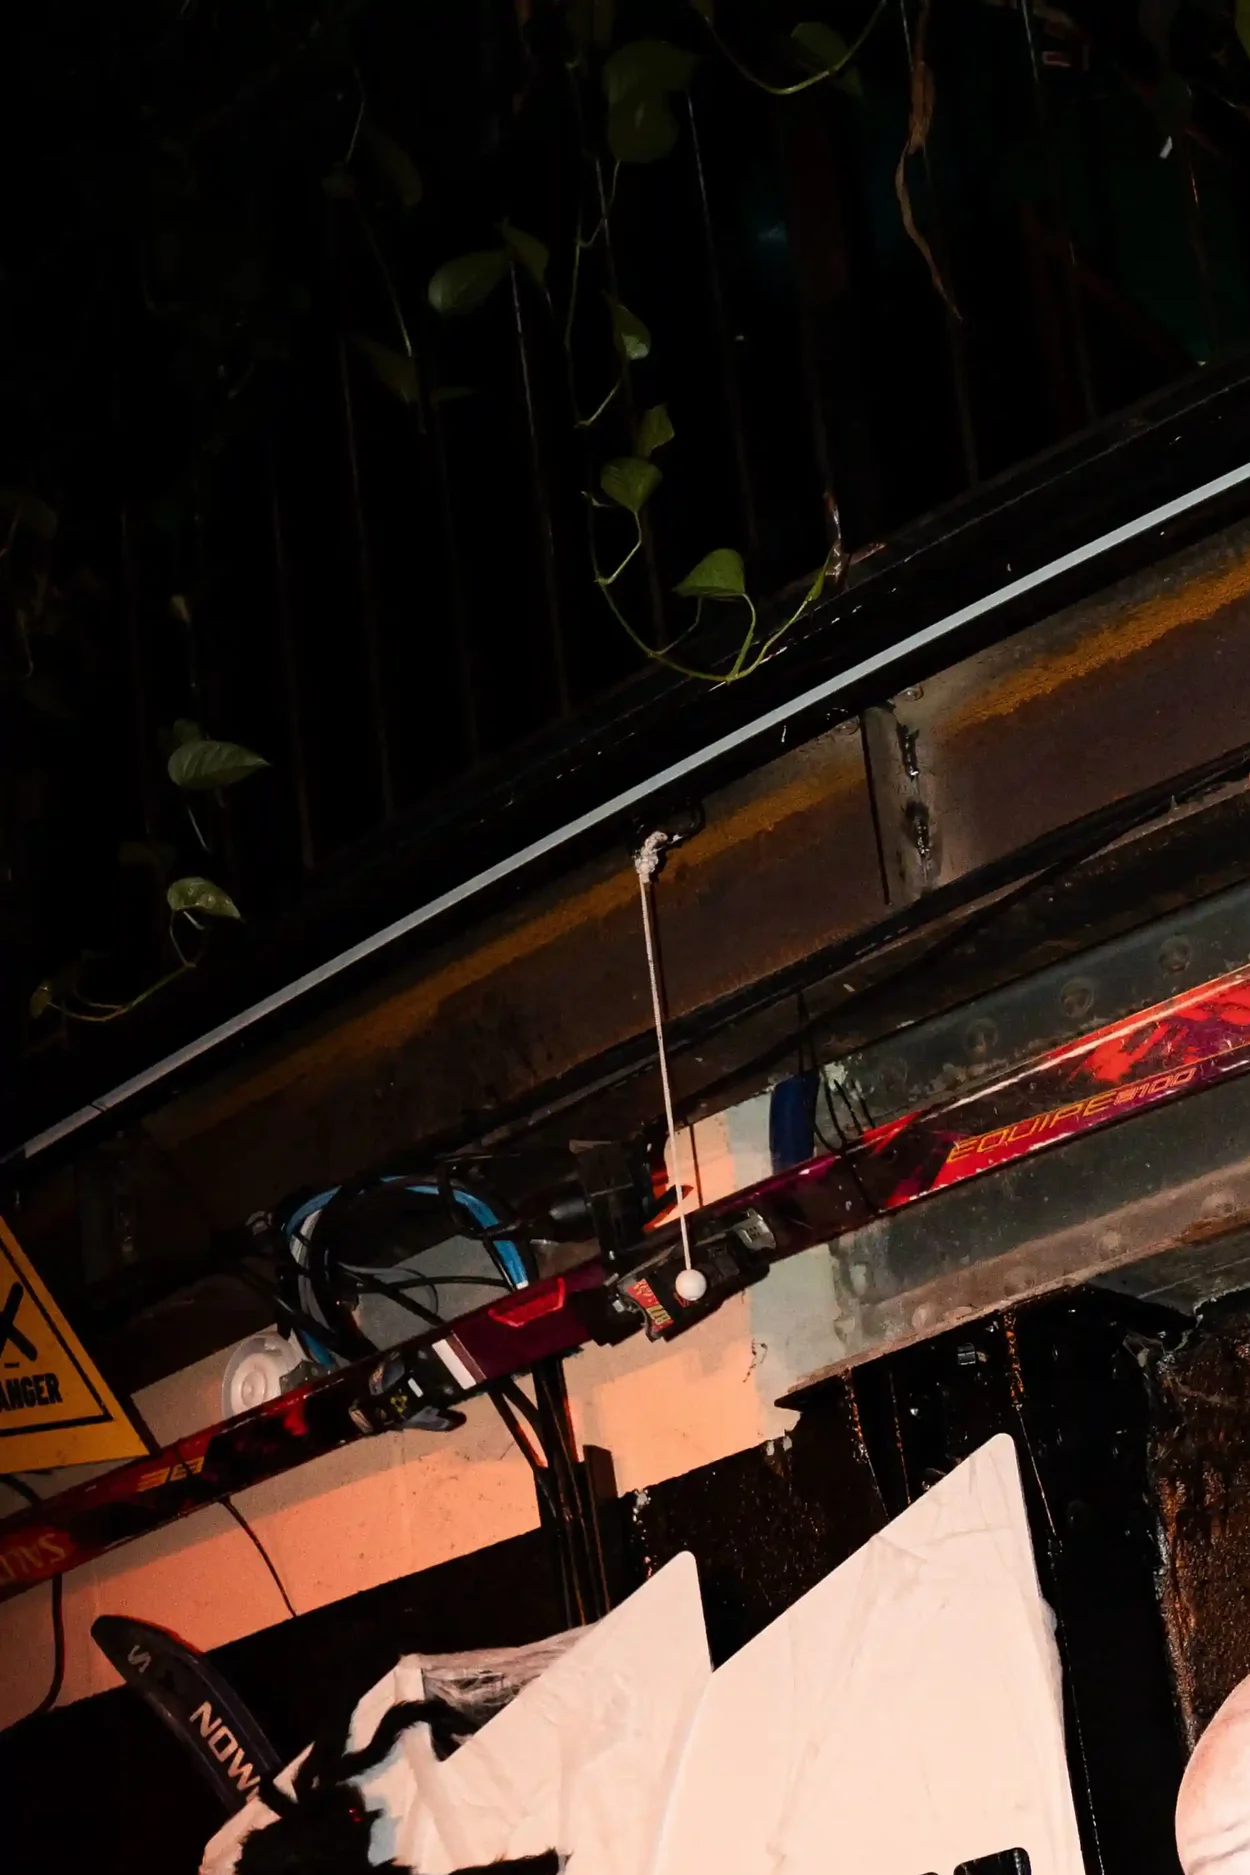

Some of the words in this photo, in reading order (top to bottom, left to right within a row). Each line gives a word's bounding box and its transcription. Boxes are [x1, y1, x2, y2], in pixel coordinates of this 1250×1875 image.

[946, 1091, 1117, 1163] EQUIPE
[0, 1373, 63, 1413] ANGER
[189, 1700, 261, 1803] NOW
